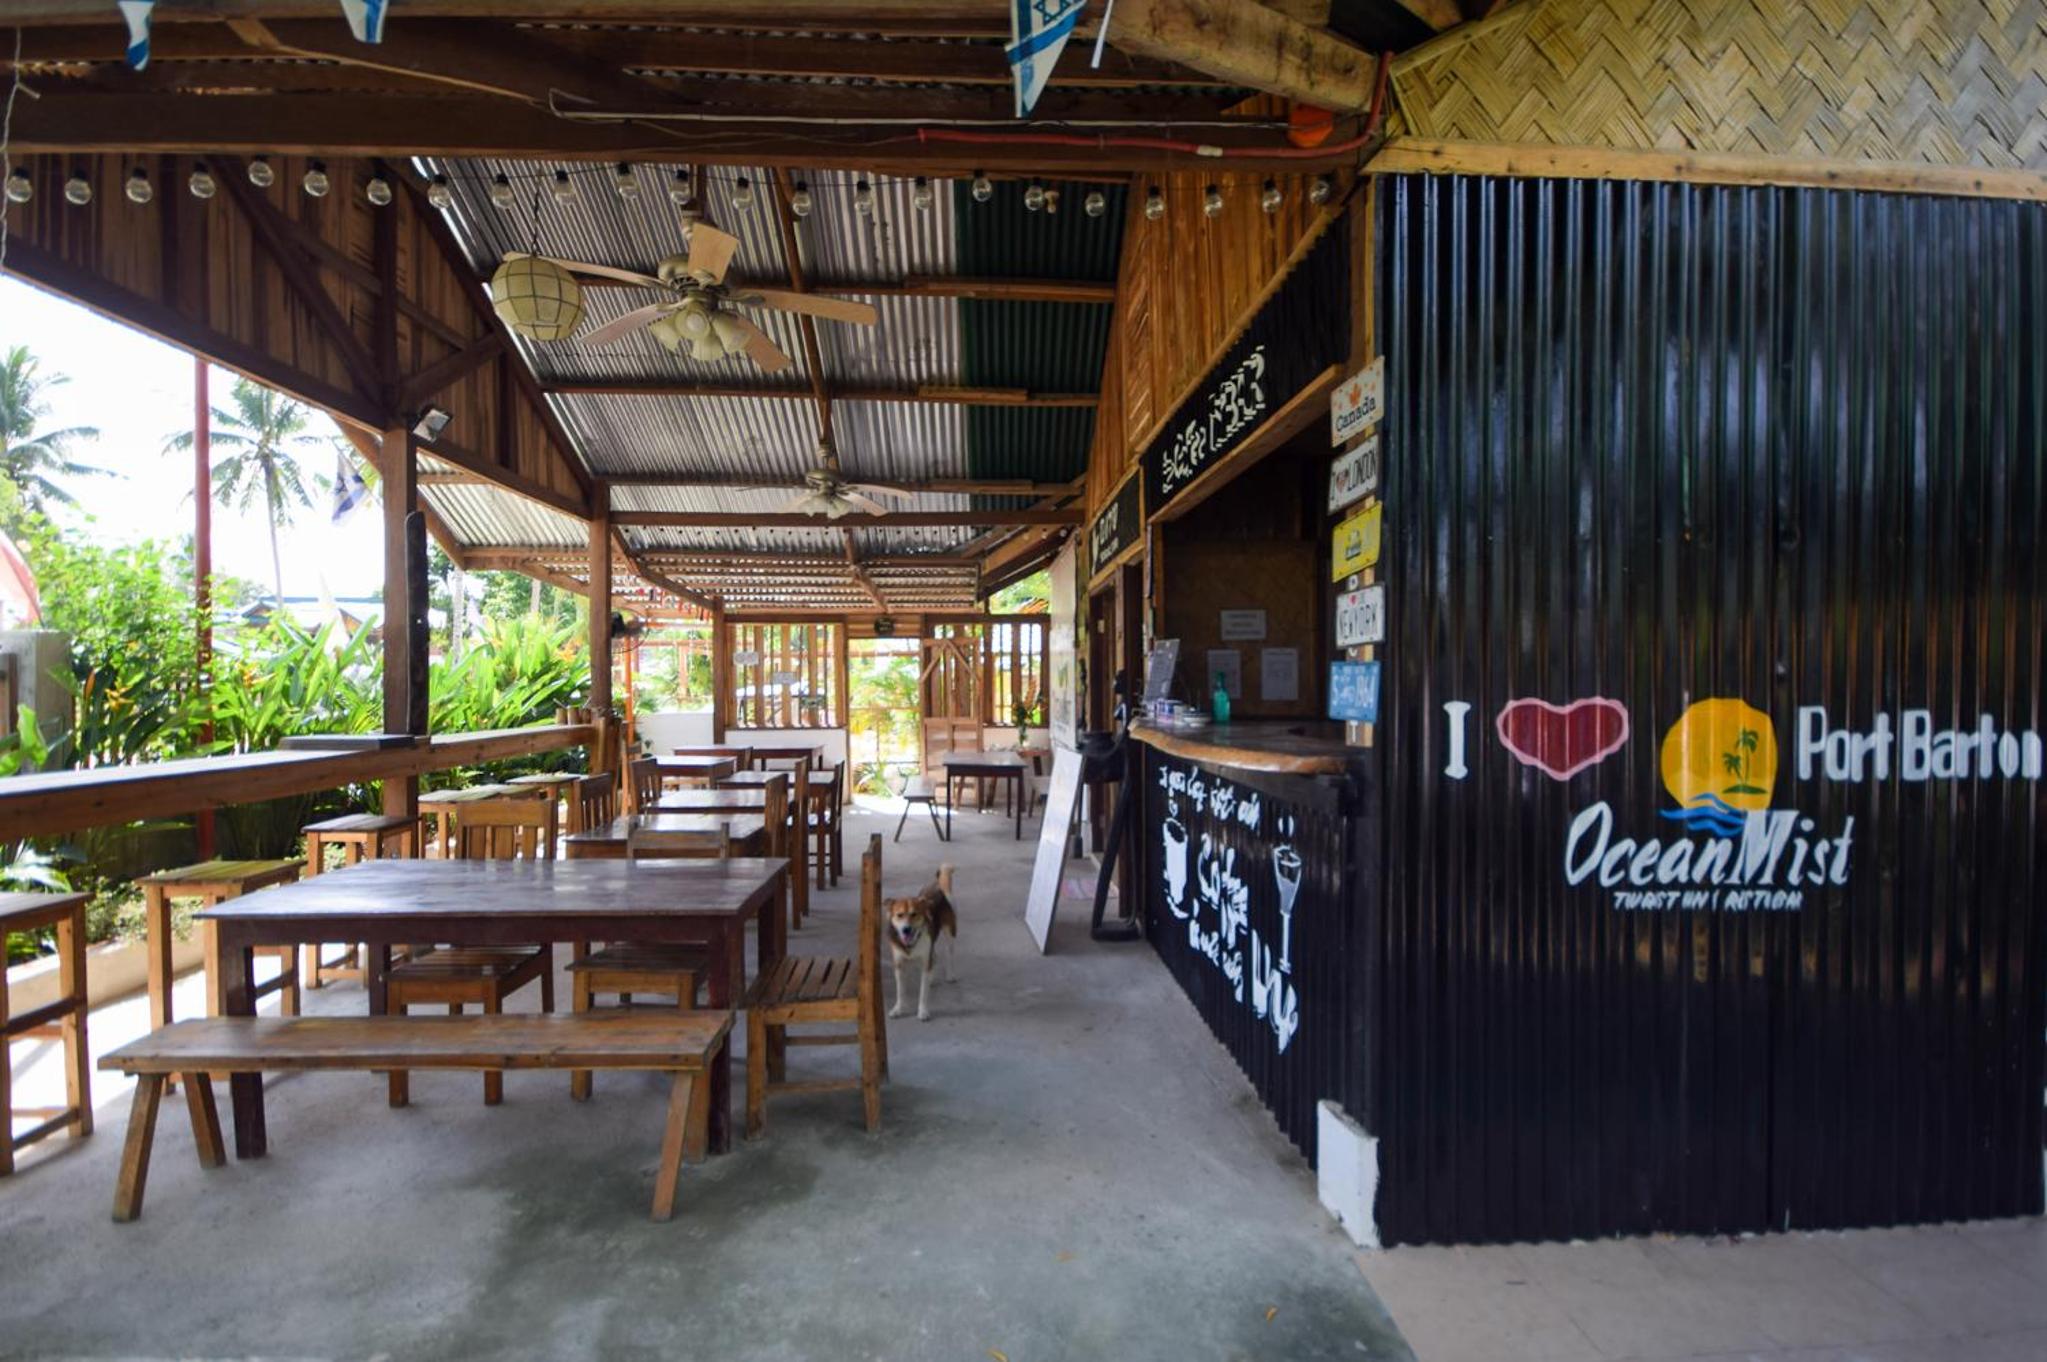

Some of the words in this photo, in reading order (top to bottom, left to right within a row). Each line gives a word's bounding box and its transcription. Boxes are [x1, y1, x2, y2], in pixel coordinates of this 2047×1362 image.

[1336, 395, 1377, 432] Canada
[1443, 701, 1471, 779] I
[1798, 705, 1894, 782] Port
[1902, 709, 2042, 782] Barton
